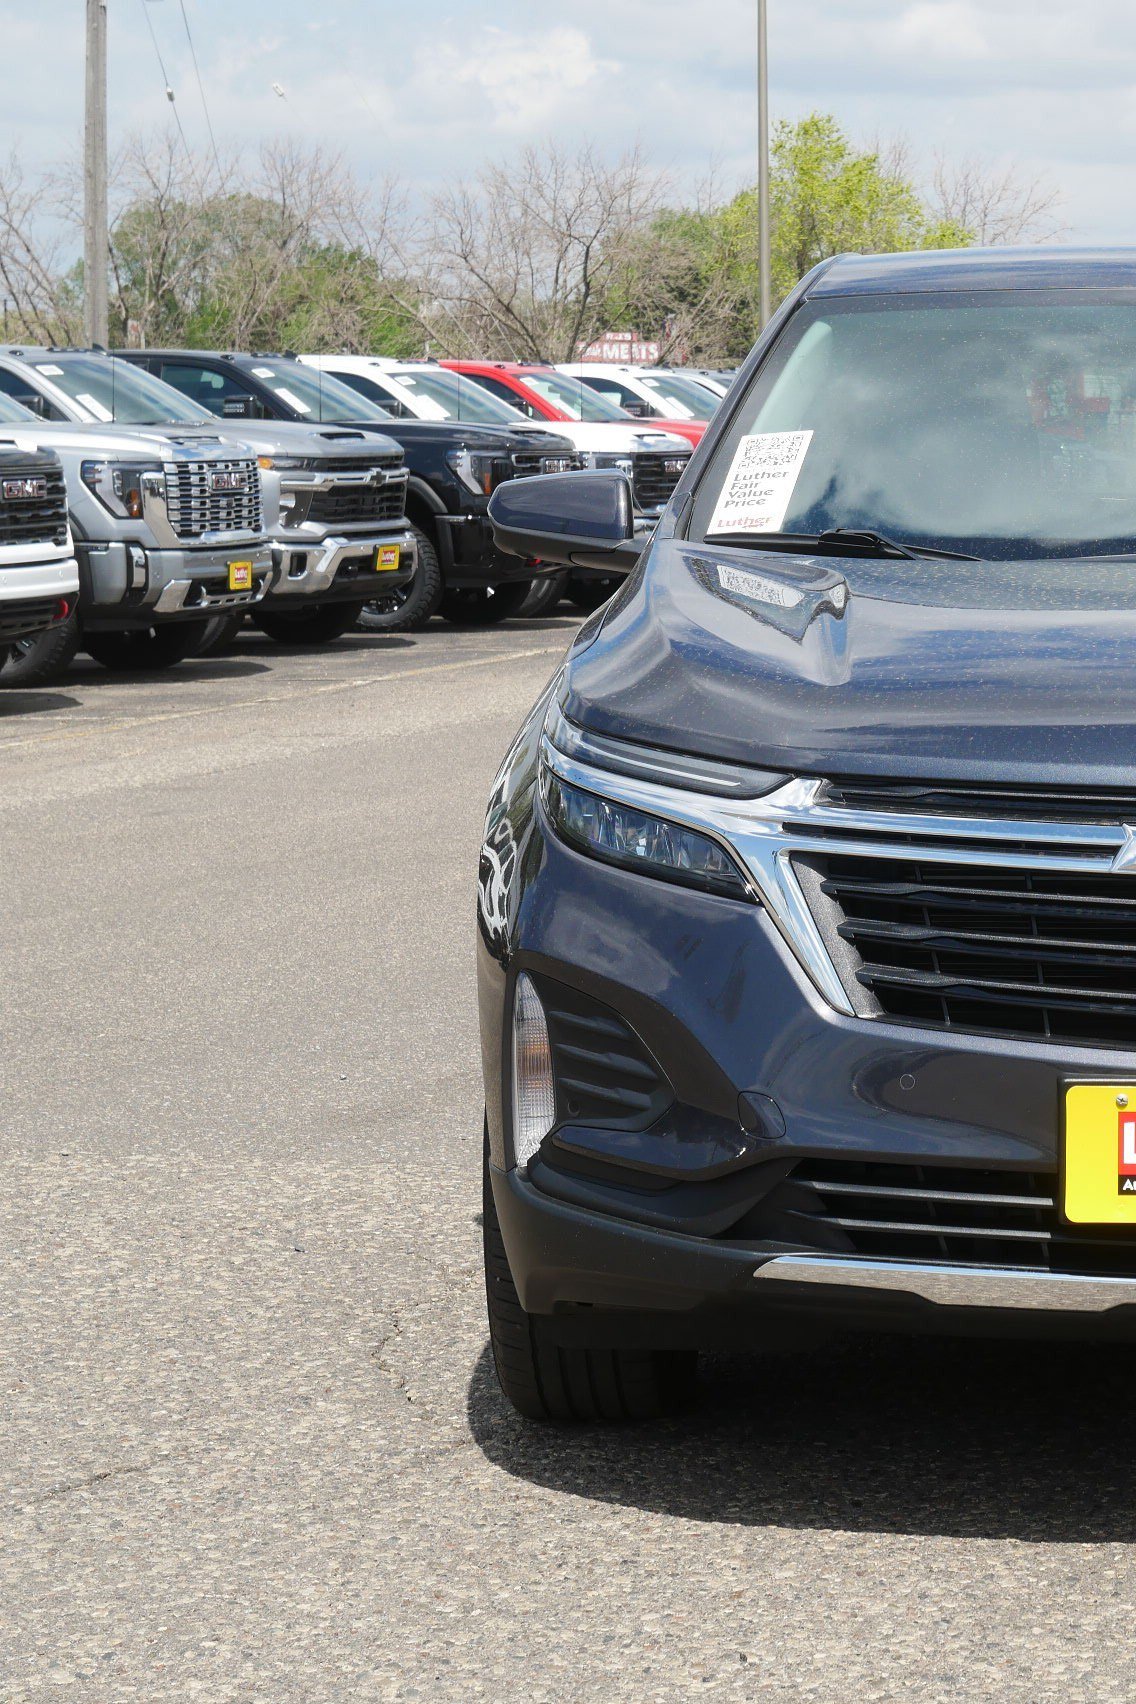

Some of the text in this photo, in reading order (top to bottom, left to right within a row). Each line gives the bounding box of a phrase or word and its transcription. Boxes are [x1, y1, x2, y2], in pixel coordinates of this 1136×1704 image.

[603, 342, 659, 360] MEATS
[212, 472, 248, 490] GMC
[734, 471, 789, 481] Luther
[3, 479, 47, 498] GMC
[731, 481, 760, 490] Fair
[728, 489, 774, 498] Value
[724, 499, 766, 508] Price
[717, 516, 771, 528] Luther
